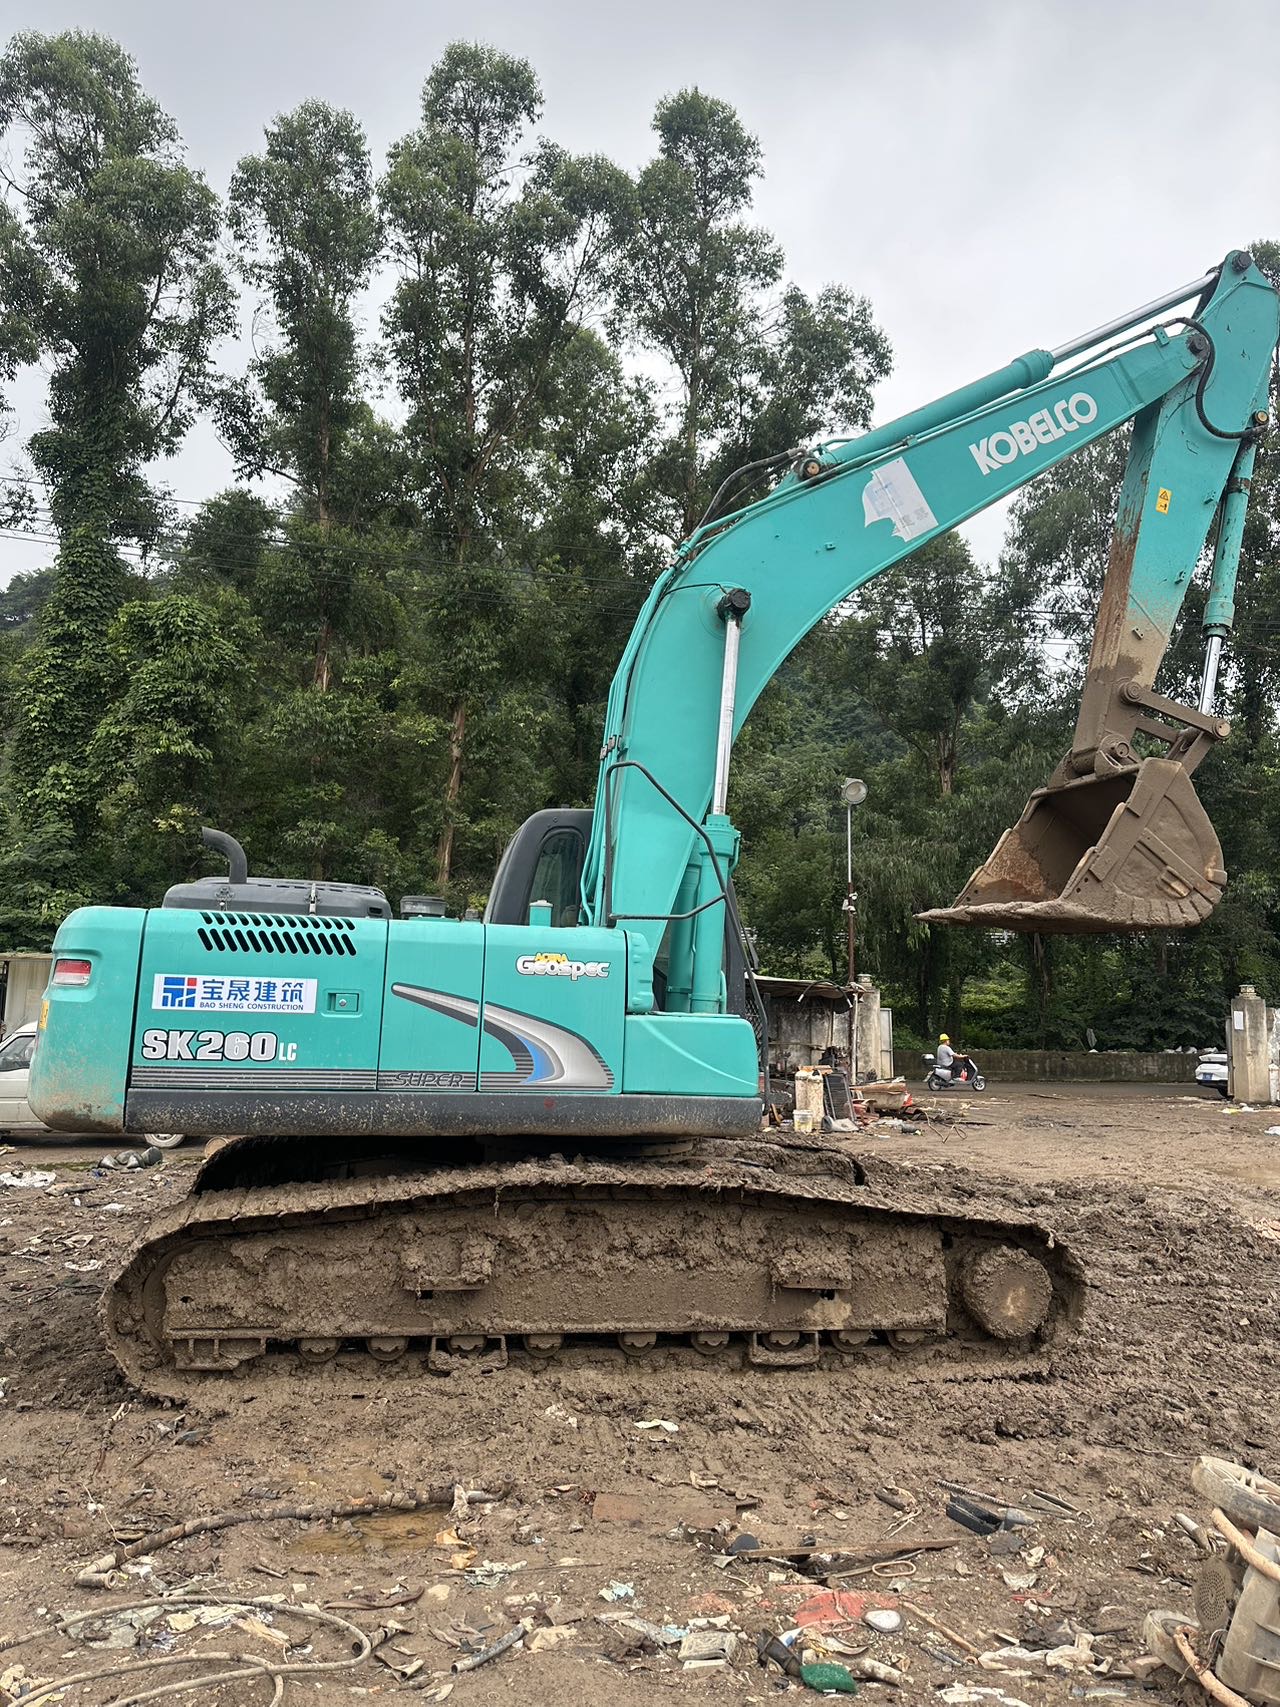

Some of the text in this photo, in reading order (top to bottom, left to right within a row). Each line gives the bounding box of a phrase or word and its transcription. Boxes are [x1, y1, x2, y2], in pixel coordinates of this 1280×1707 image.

[969, 392, 1097, 476] KOBELCO
[201, 979, 304, 1003] 宝晟建筑
[199, 1001, 216, 1009] BAO
[247, 1002, 304, 1011] CONSTRUCTION
[396, 1072, 464, 1088] SUPER
